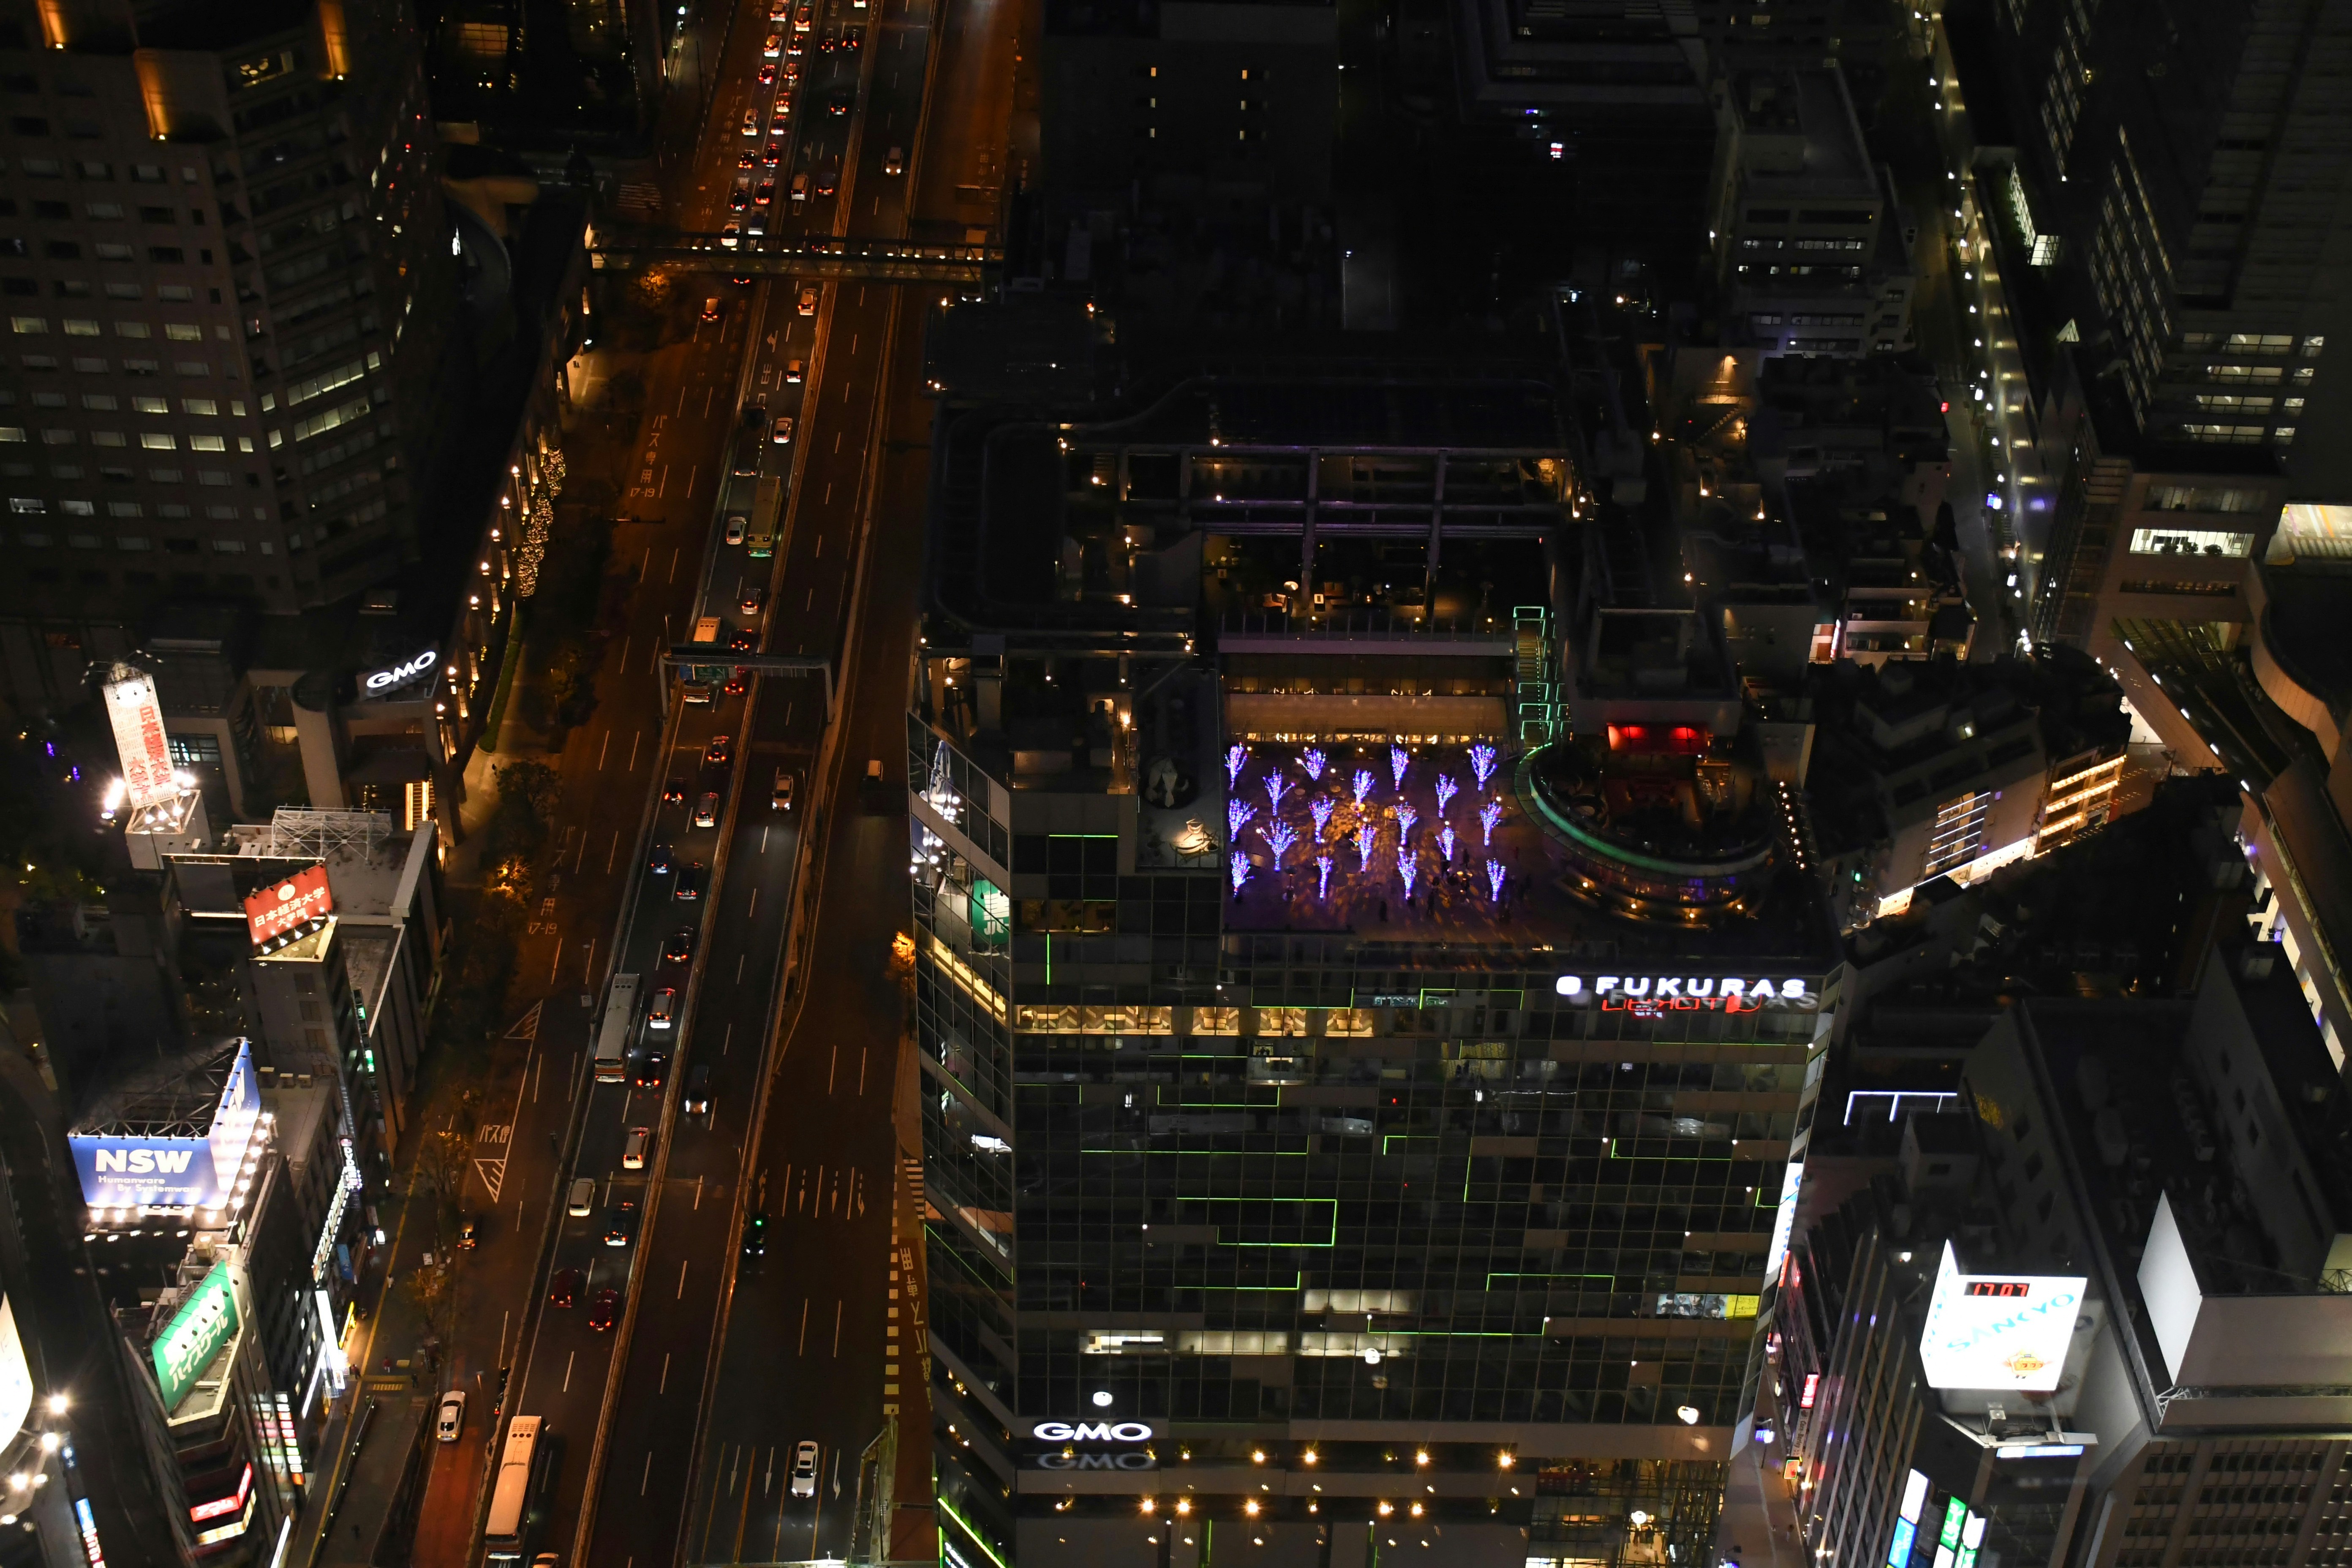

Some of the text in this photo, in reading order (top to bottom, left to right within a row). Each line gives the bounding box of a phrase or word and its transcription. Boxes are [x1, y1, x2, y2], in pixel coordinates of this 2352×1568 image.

[640, 415, 667, 484] バス専用
[630, 488, 655, 497] 17-19
[367, 651, 436, 688] GMO
[254, 886, 325, 928] 日本経済大学
[528, 922, 558, 935] 17-19
[1595, 977, 1806, 998] FUKURAS
[479, 1124, 511, 1143] バス停
[95, 1149, 193, 1173] NSW
[98, 1176, 165, 1184] Humanware
[135, 1184, 202, 1193] Systemware
[1946, 1294, 2074, 1352] SANKYO
[173, 1314, 228, 1393] ハイスクール
[1034, 1423, 1152, 1440] GMO
